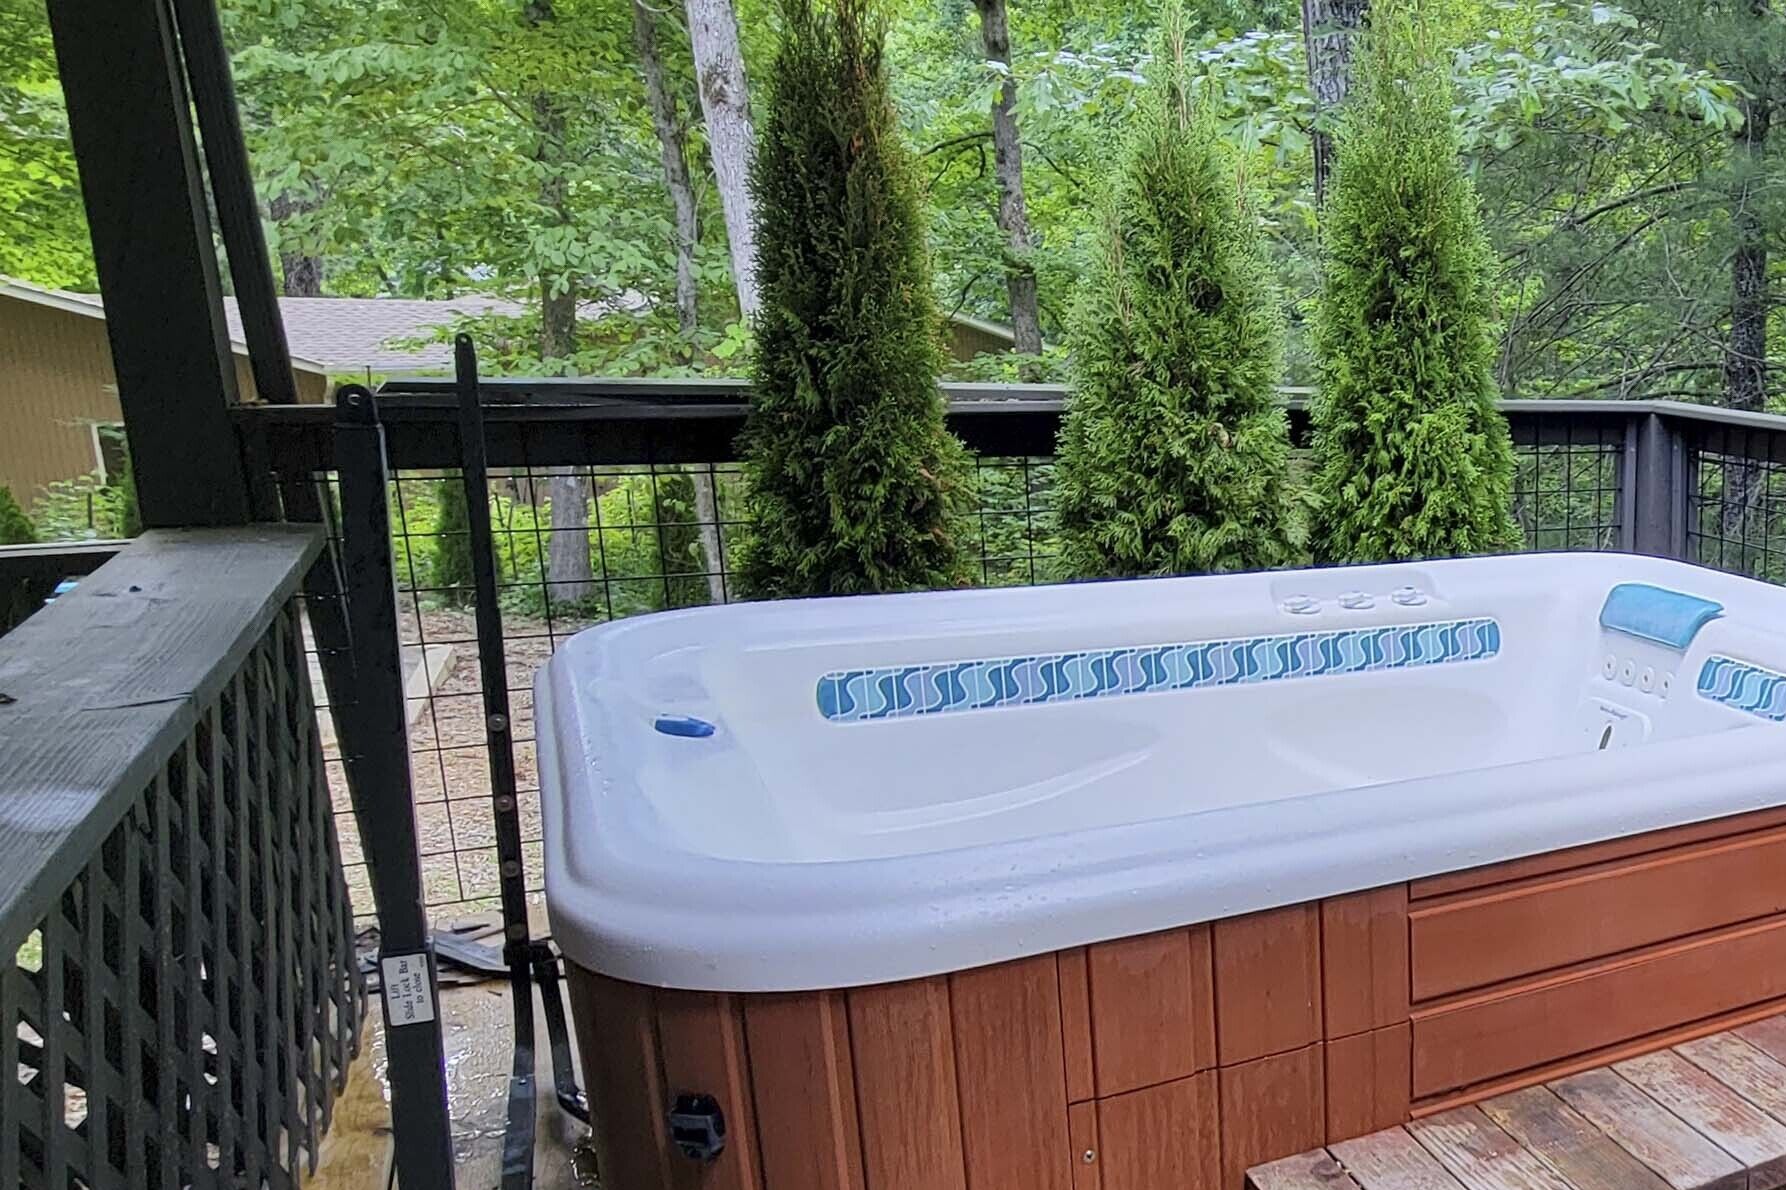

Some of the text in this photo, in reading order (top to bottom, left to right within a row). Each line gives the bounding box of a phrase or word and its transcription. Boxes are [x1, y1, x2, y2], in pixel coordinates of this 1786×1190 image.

[399, 960, 408, 974] Bar
[401, 977, 412, 998] Lock
[413, 972, 423, 992] close
[416, 995, 424, 1004] to
